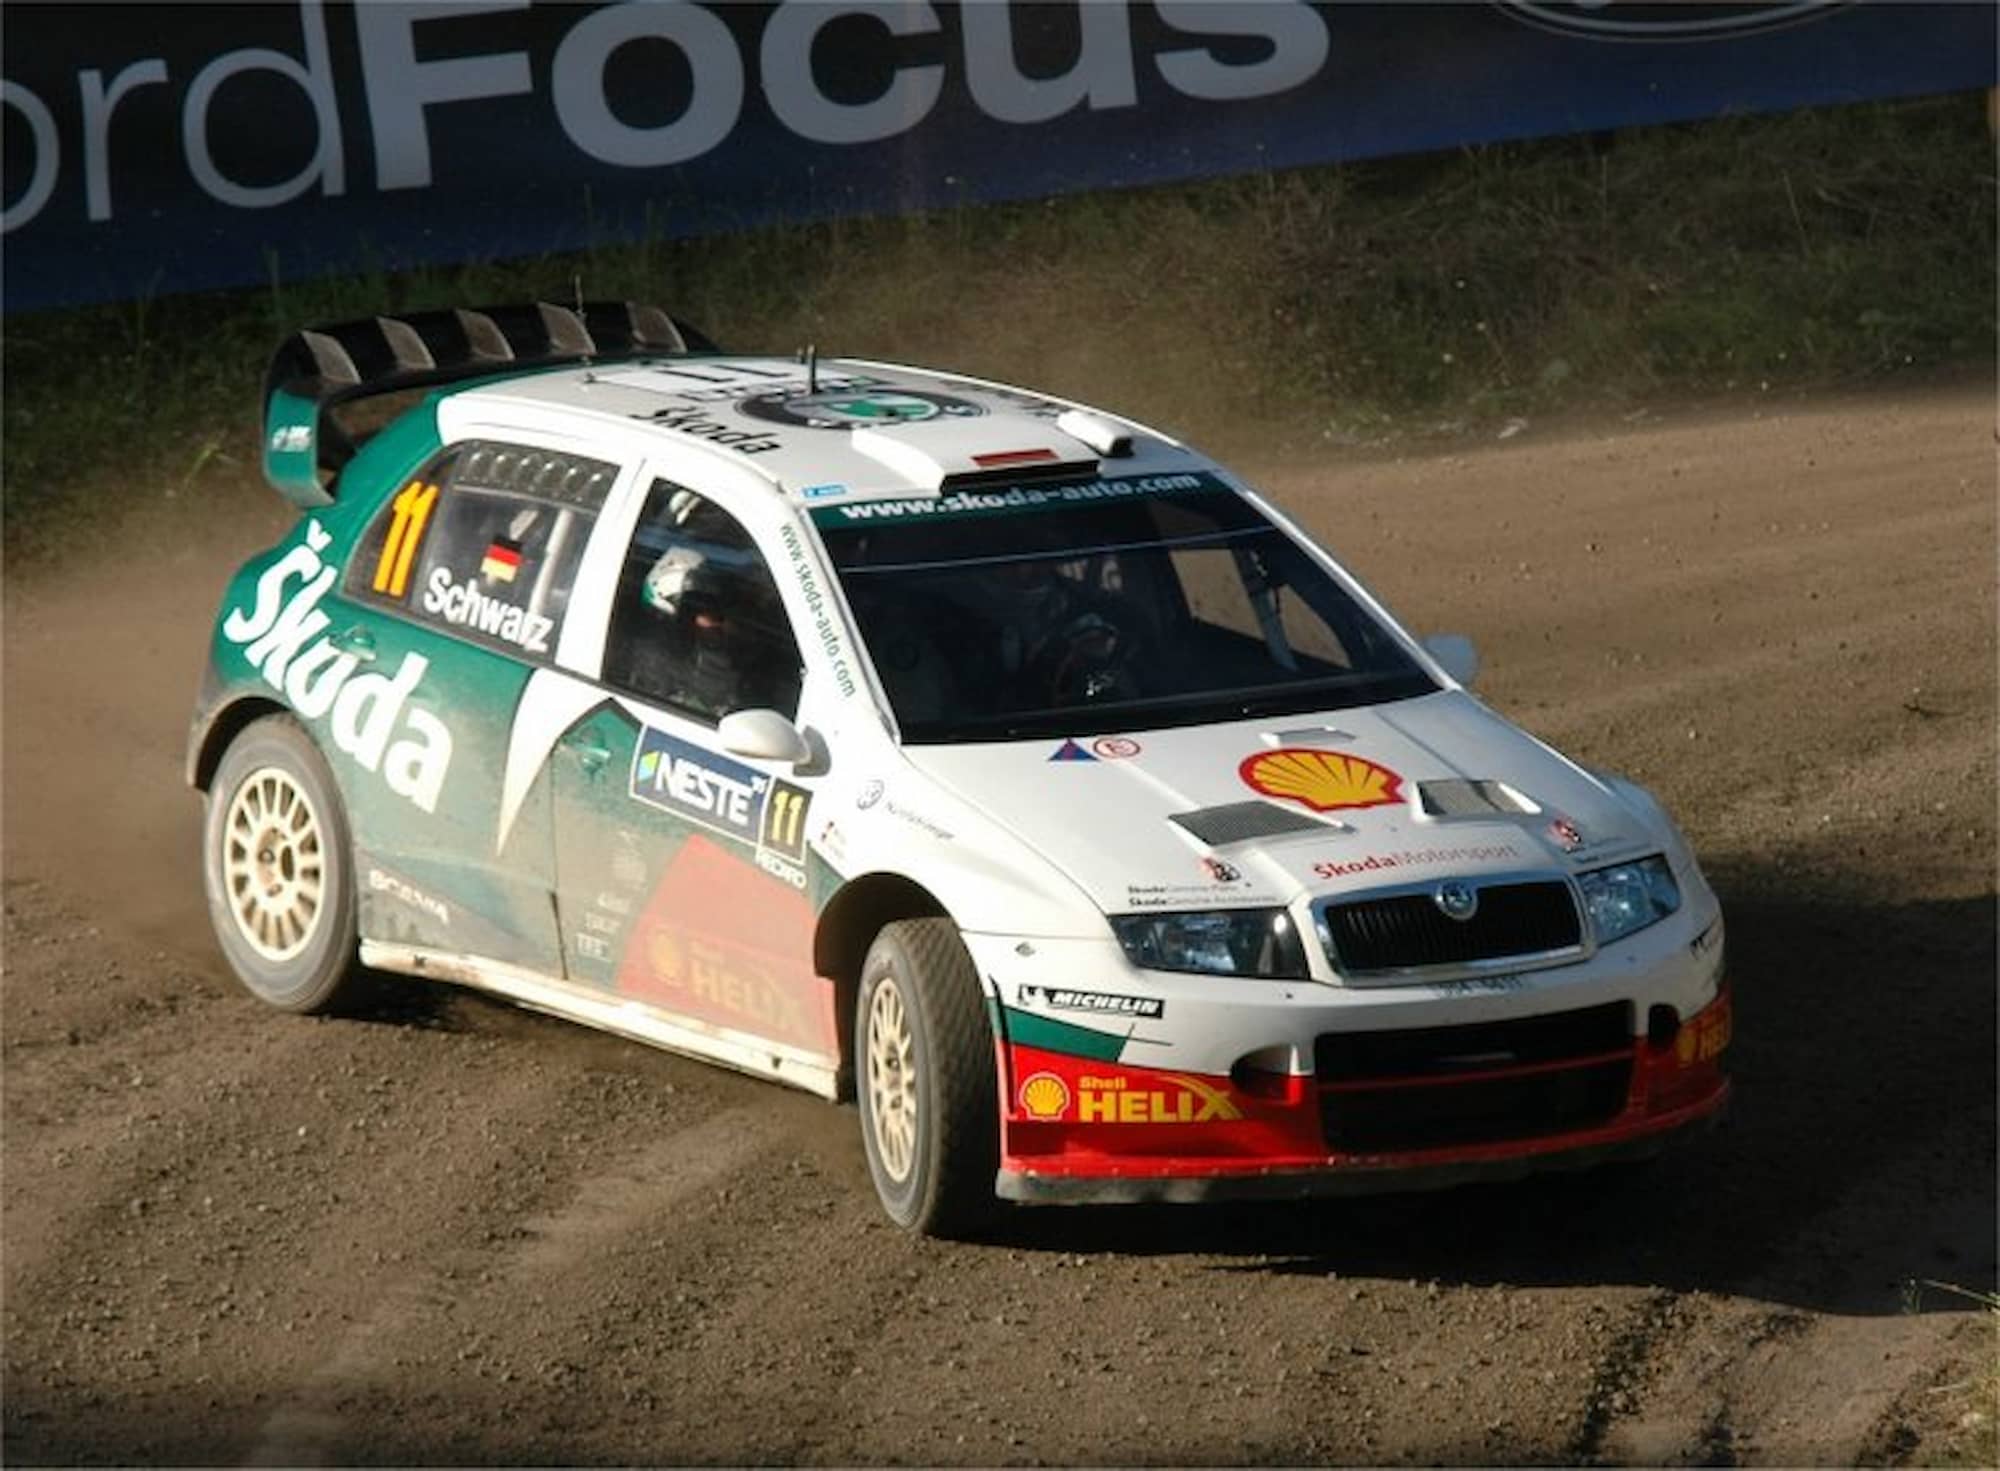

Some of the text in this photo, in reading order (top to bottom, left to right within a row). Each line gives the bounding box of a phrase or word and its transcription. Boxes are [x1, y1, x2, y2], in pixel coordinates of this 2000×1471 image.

[839, 472, 1200, 520] www.skoda-auto.com
[373, 481, 438, 597] 11
[423, 567, 553, 651] Schwarz
[781, 523, 856, 699] www.skoda-auto.com
[655, 750, 753, 826] NESTE
[772, 790, 804, 846] 11
[1052, 992, 1159, 1014] MICHELIN
[1078, 1083, 1245, 1123] HELIX
[1079, 1076, 1127, 1090] Shell
